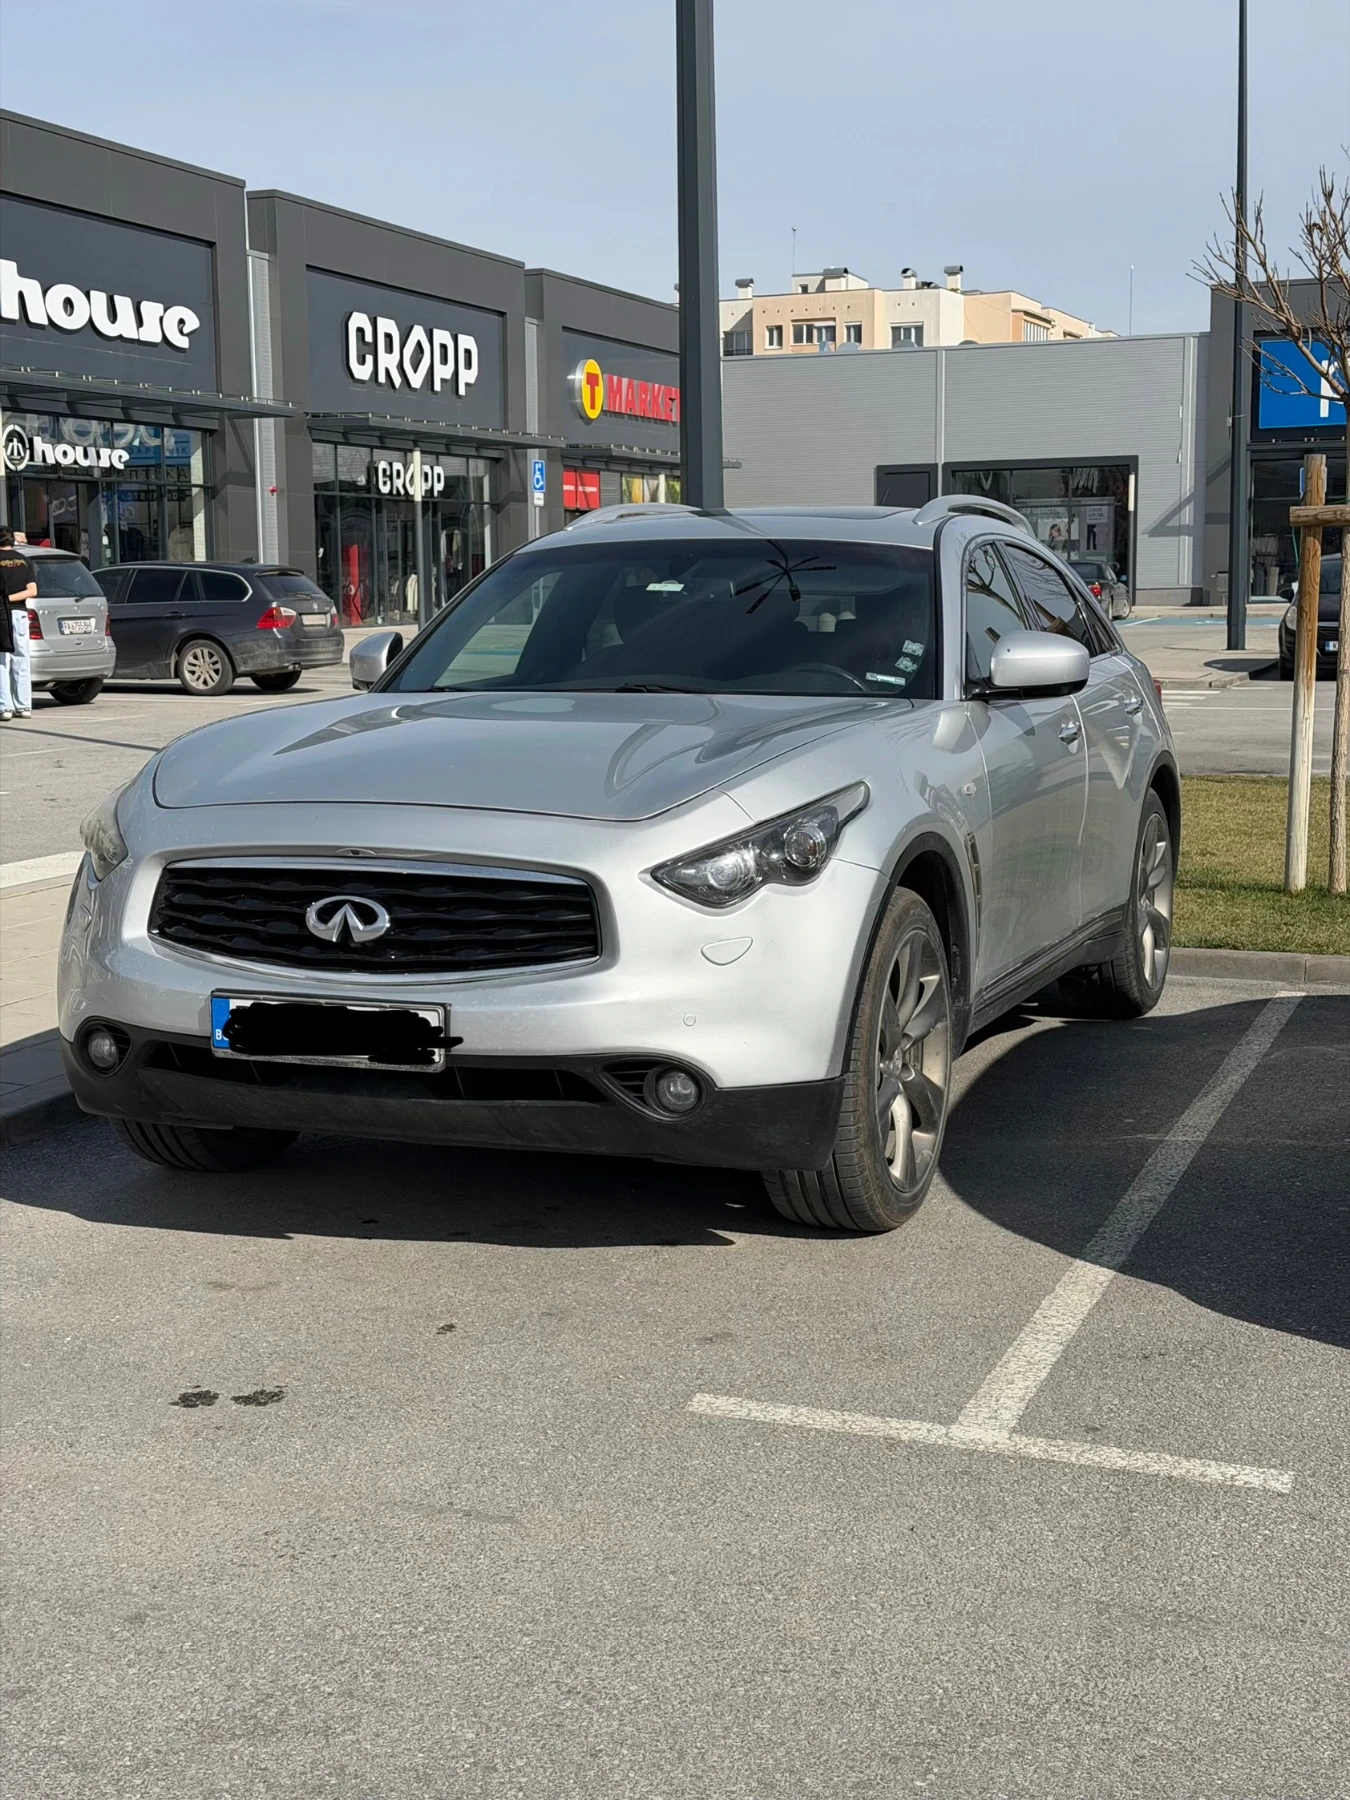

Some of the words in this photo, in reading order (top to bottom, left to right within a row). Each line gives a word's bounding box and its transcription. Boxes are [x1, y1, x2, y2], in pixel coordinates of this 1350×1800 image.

[0, 259, 200, 348] house
[348, 311, 478, 396] CROPP
[586, 372, 599, 410] T
[33, 436, 130, 470] house
